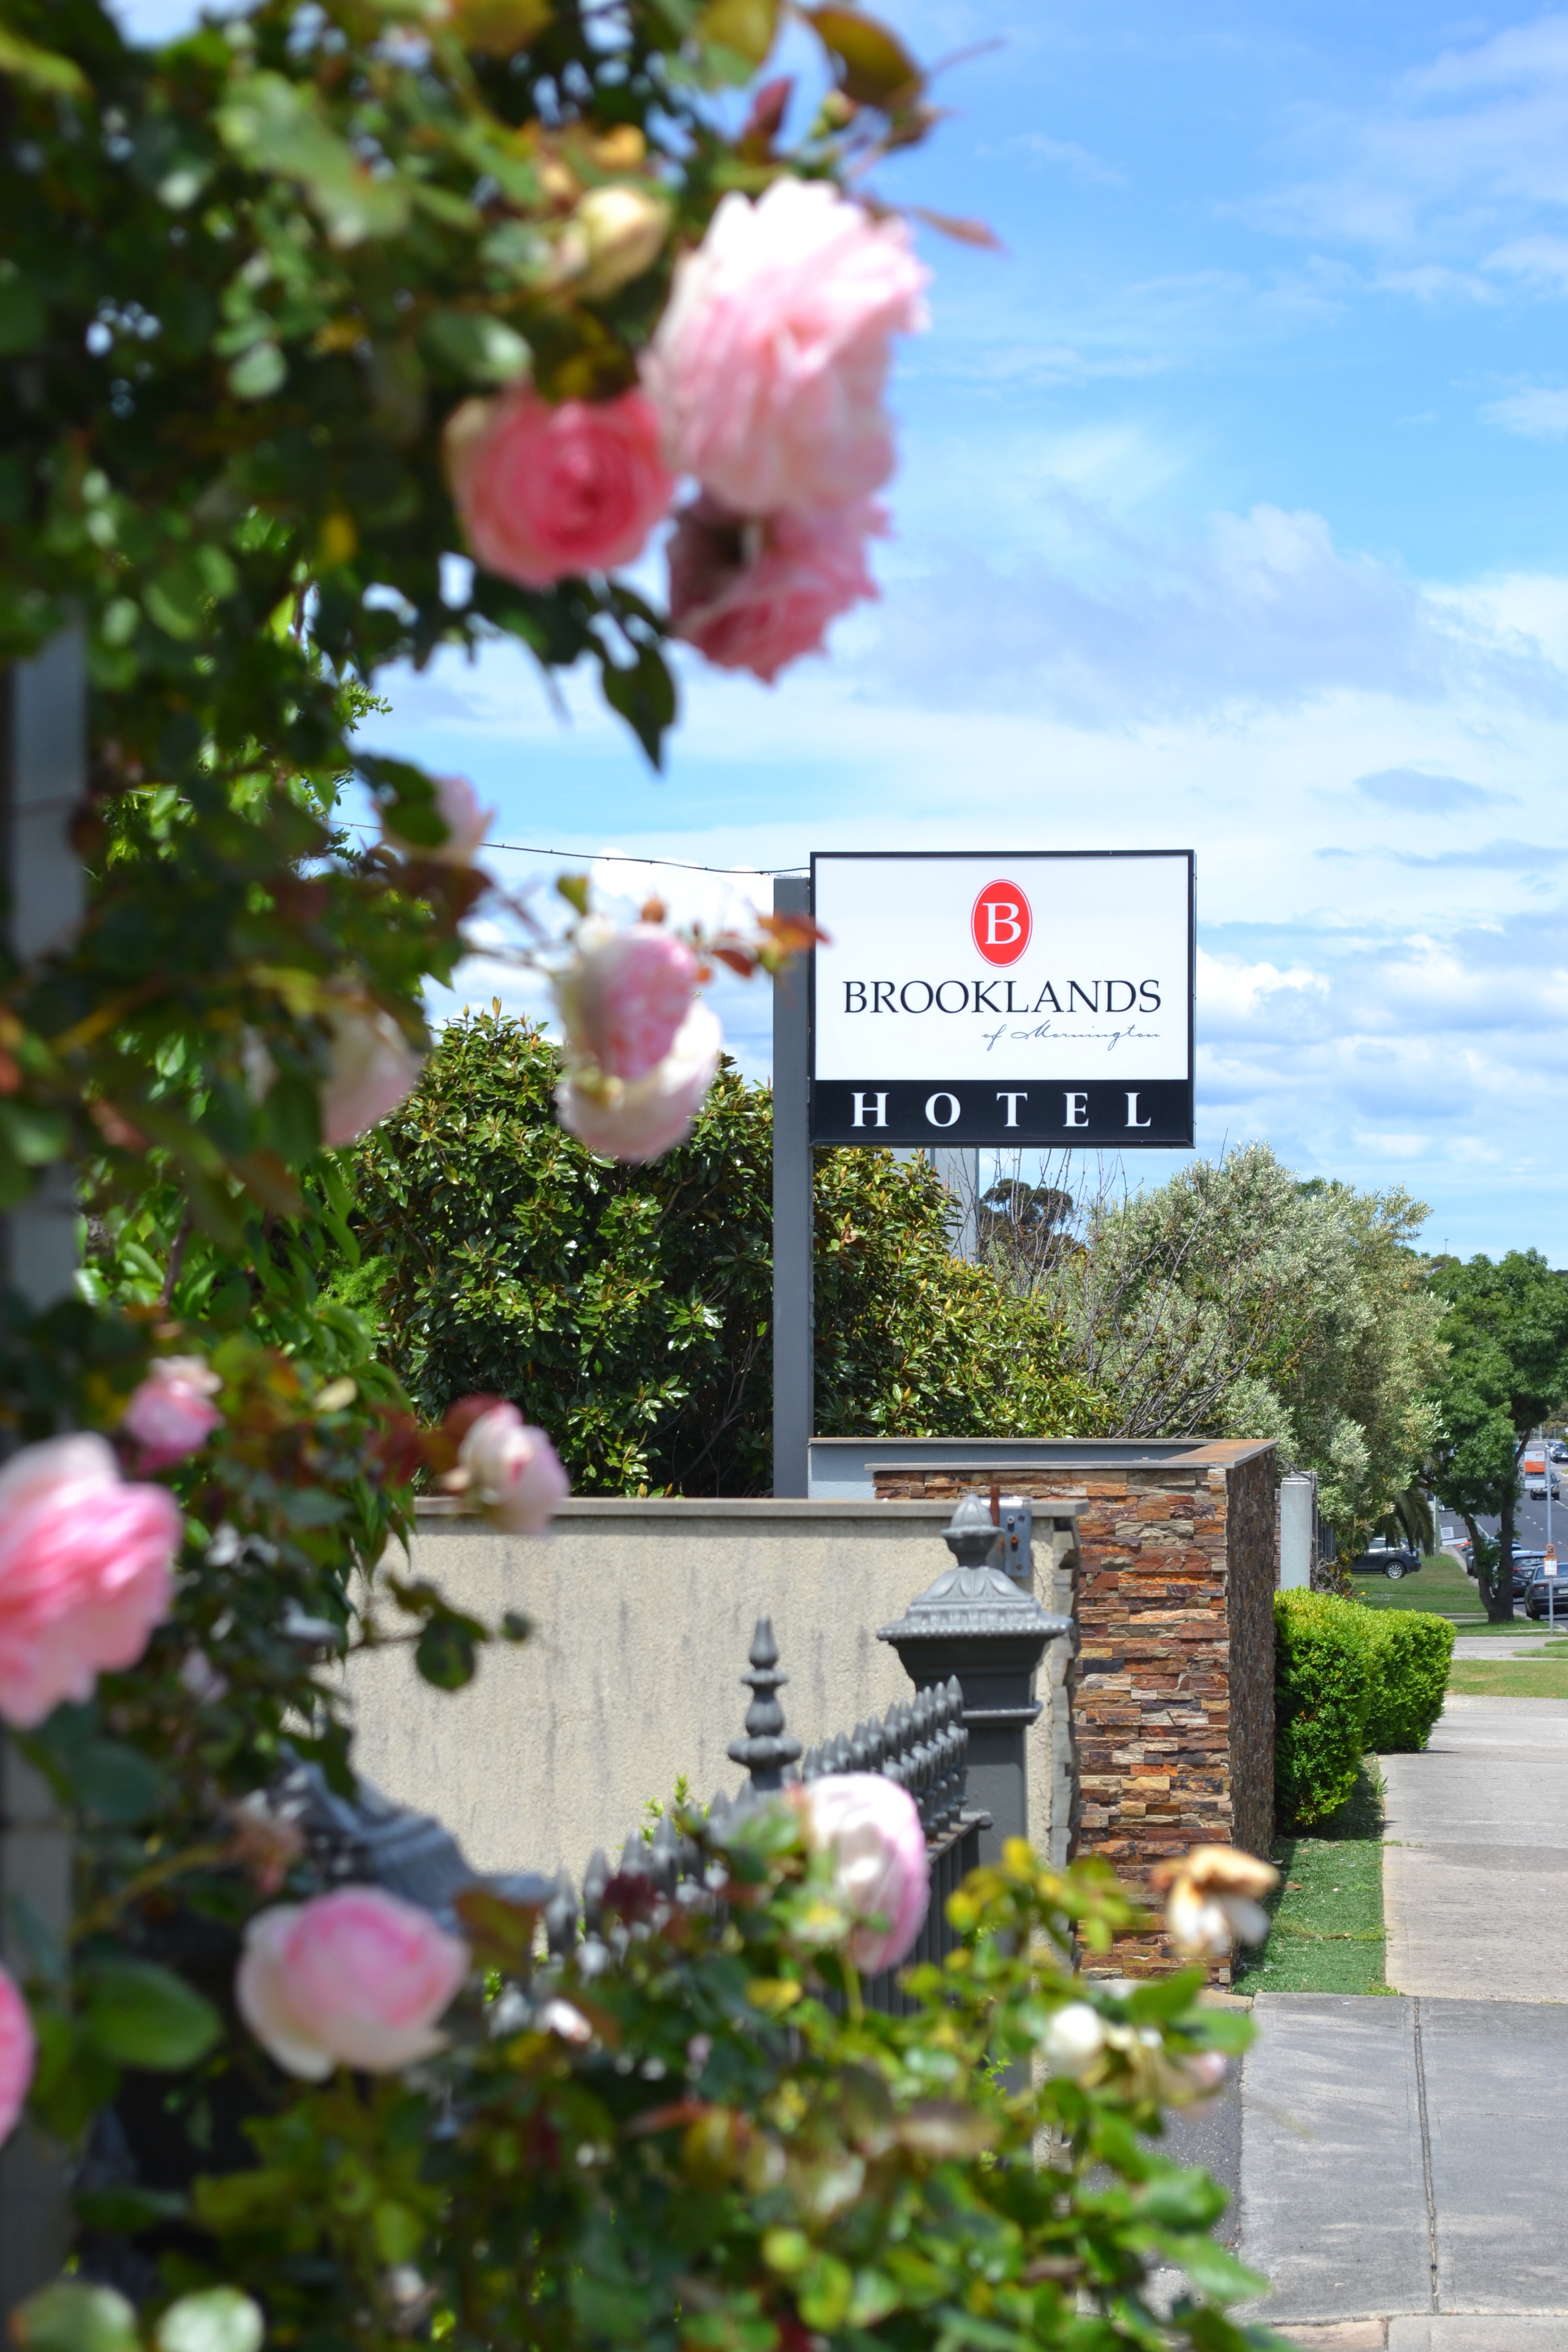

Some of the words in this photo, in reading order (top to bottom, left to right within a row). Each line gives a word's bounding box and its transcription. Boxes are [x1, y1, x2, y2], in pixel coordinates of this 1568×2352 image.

[982, 902, 1022, 945] B
[842, 979, 1162, 1014] BROOKLANDS
[982, 1024, 1007, 1051] of
[1011, 1019, 1161, 1051] Mornington
[851, 1092, 1152, 1127] HOTEL
